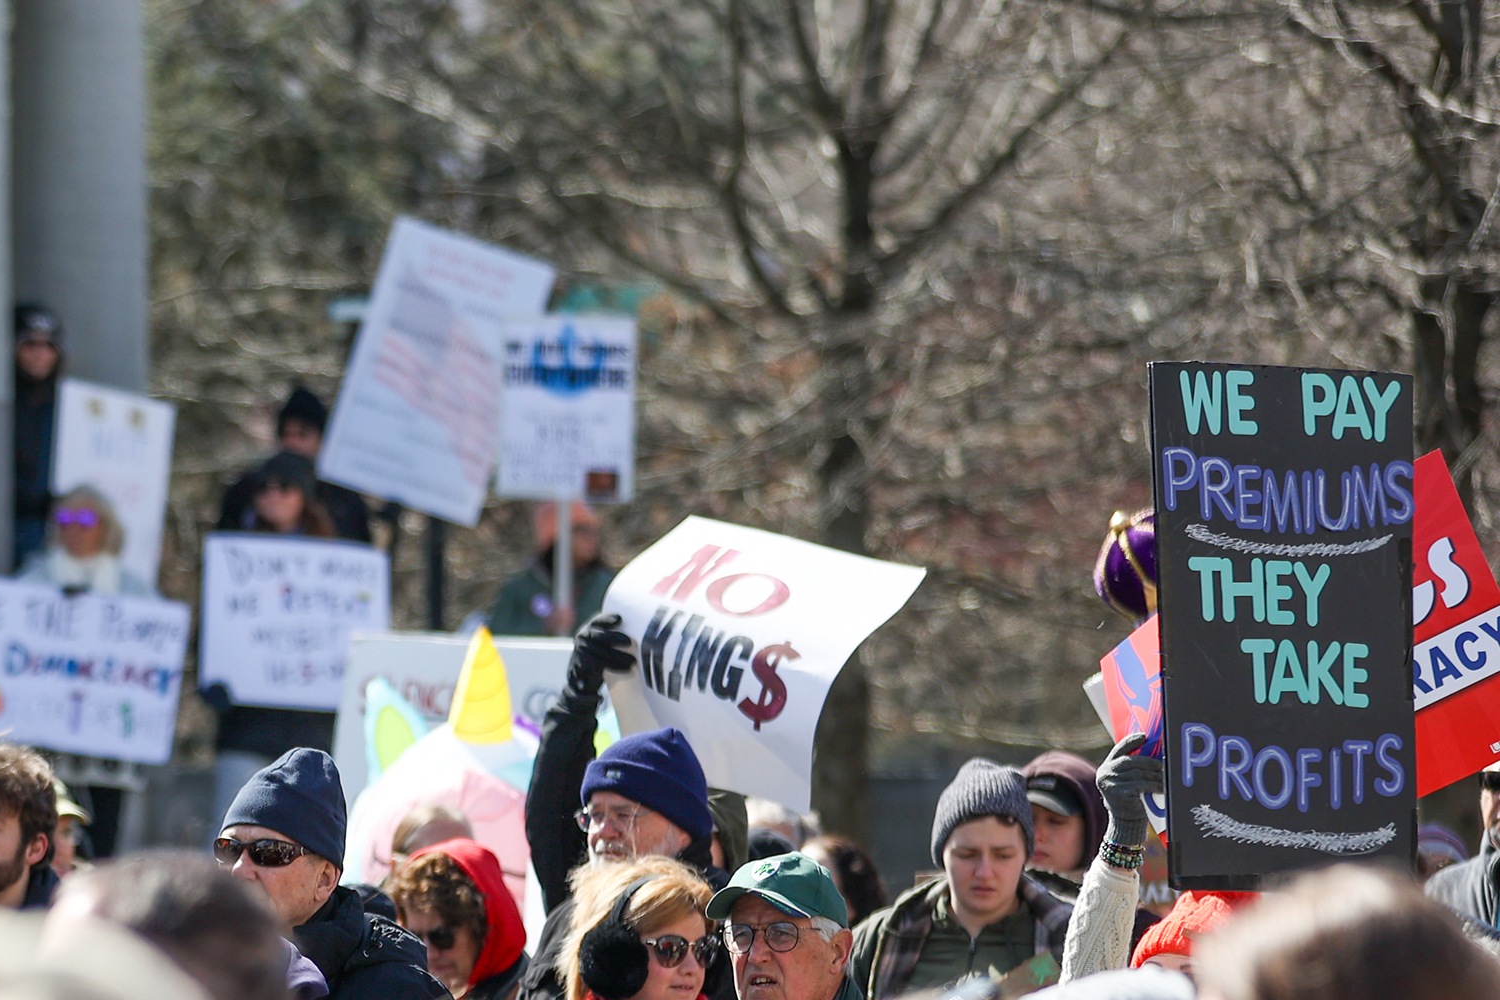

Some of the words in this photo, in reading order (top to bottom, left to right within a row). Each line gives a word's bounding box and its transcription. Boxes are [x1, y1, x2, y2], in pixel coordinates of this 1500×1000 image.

[1179, 370, 1259, 436] WE
[1301, 372, 1401, 443] PAY
[1162, 446, 1415, 534] PREMIUMS
[650, 544, 790, 618] NO
[1188, 556, 1331, 627] THEY
[641, 604, 802, 732] KING$
[1240, 638, 1370, 708] TAKE
[1181, 722, 1405, 812] PROFITS
